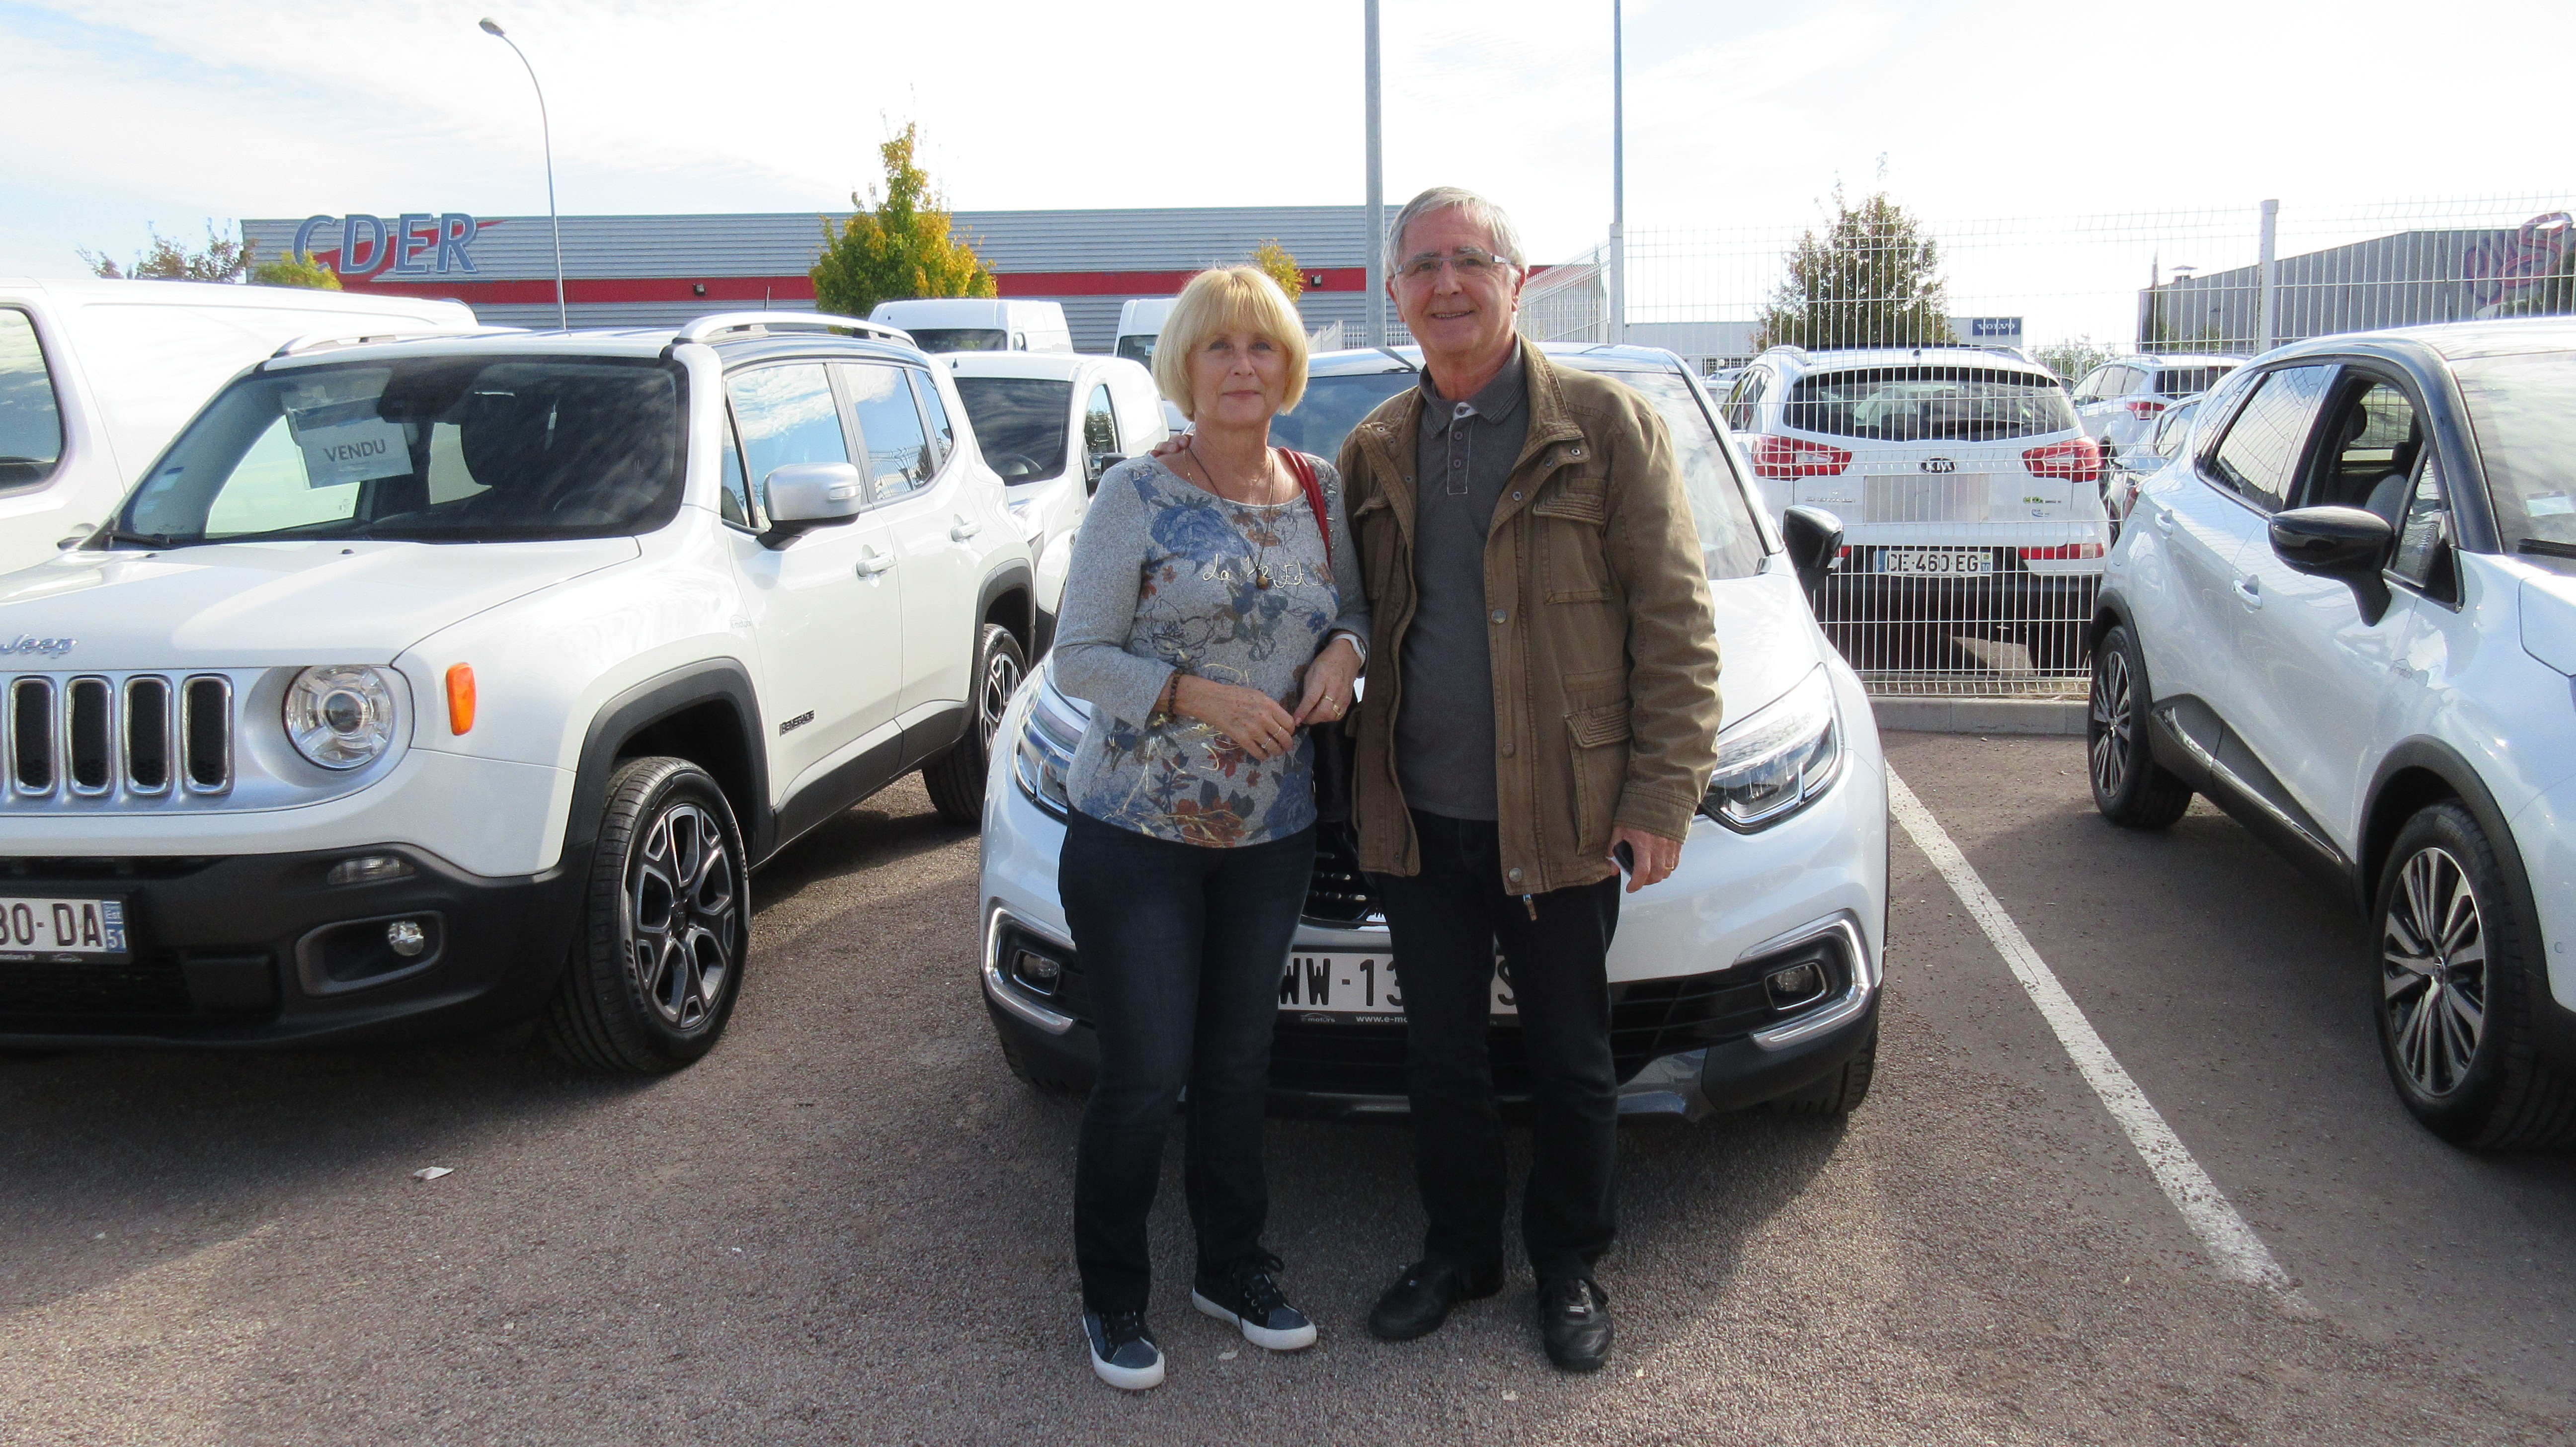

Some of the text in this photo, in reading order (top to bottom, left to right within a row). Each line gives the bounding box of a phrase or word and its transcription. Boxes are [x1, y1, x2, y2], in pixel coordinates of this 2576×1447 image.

[293, 213, 478, 275] CDER
[324, 439, 386, 462] VENDU
[1245, 555, 1274, 580] Ve
[0, 634, 79, 659] Jeep
[106, 929, 127, 949] 51
